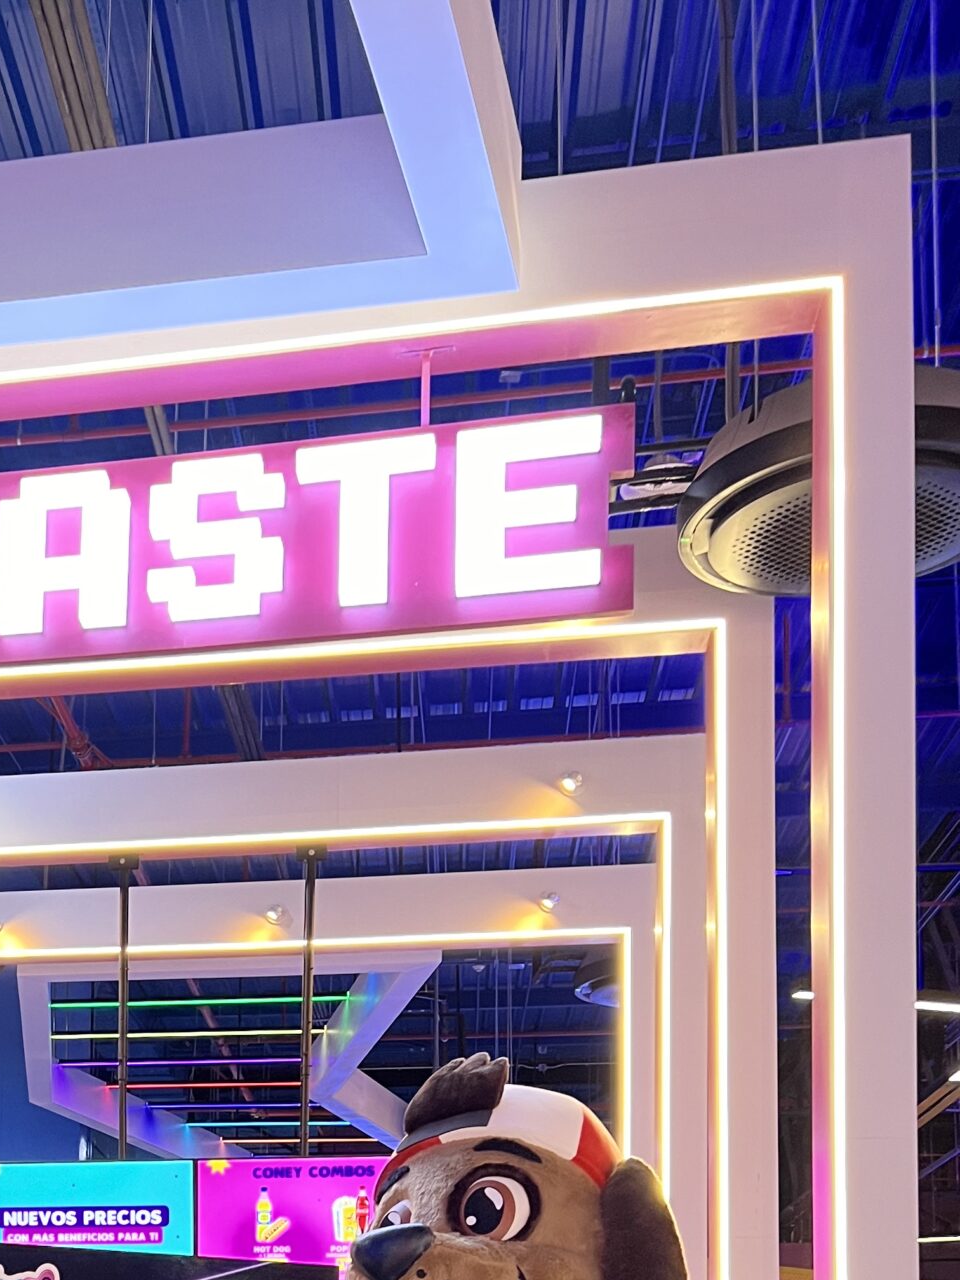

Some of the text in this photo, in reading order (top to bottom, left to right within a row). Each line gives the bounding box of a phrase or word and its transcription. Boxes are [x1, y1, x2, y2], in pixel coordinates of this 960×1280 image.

[252, 1165, 375, 1179] CONEY COMBOS
[3, 1209, 162, 1227] NUEVOS PRECIOS
[7, 1231, 158, 1243] CON MÁS BENEFICIOS PARA TI
[272, 1245, 291, 1253] DOG
